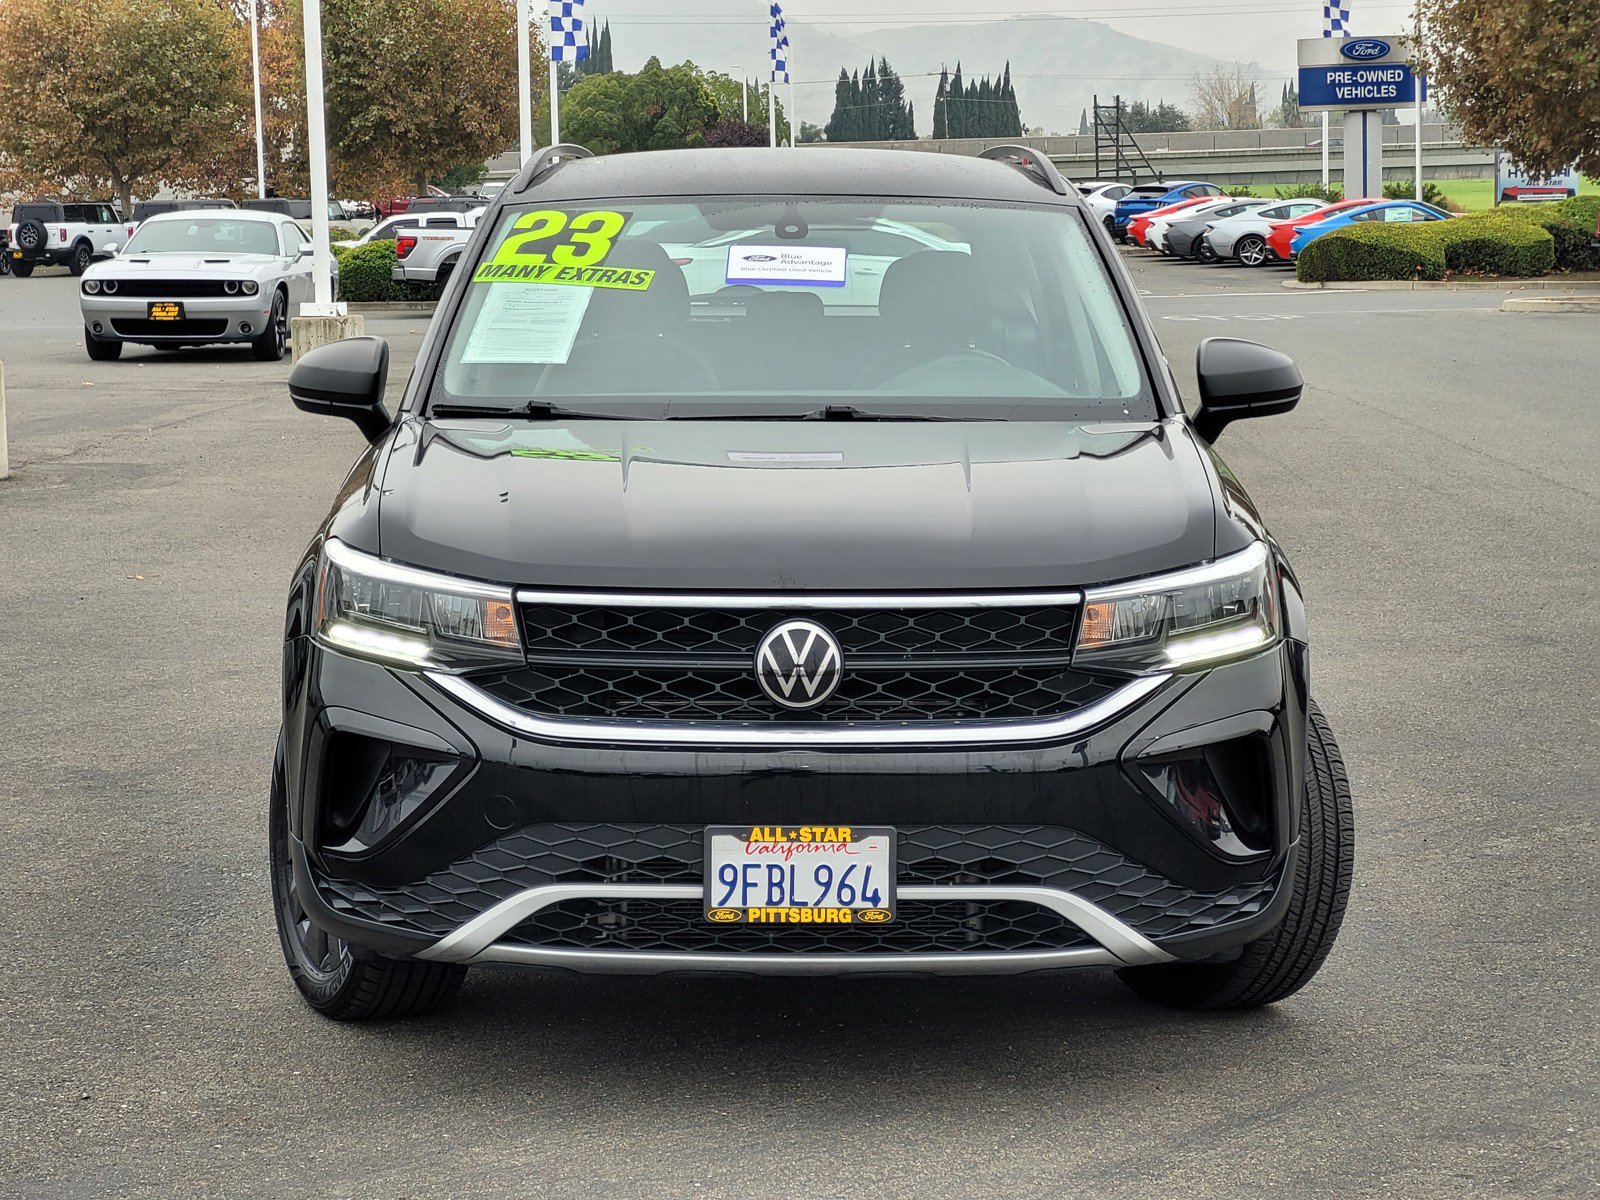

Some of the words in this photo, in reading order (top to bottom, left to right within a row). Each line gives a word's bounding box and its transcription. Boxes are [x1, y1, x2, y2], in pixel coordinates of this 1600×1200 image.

[1352, 43, 1381, 56] Ford
[1326, 69, 1404, 84] PRE-OWNED
[1335, 85, 1397, 99] VEHICLES
[492, 210, 625, 266] 23
[780, 259, 833, 267] Advantage
[477, 264, 553, 279] MANY
[553, 266, 650, 286] EXTRAS
[749, 827, 787, 842] ALL
[799, 827, 852, 842] STAR
[745, 840, 861, 862] California
[717, 863, 882, 908] 9FBL964
[713, 910, 736, 920] Ford
[748, 908, 852, 923] PITTSBURG
[864, 910, 886, 921] Ford
